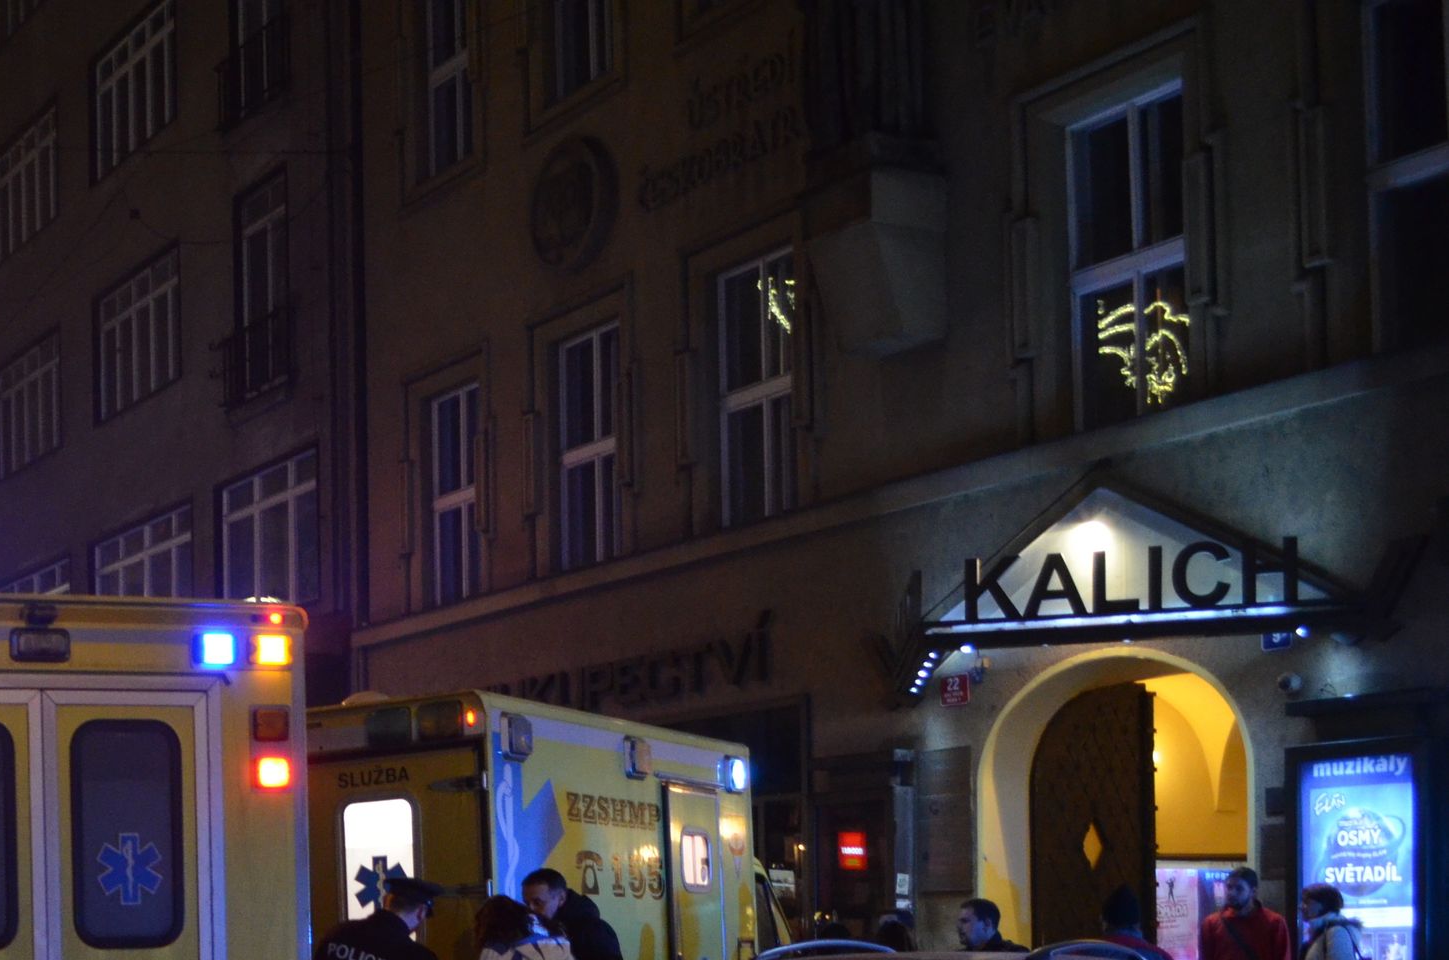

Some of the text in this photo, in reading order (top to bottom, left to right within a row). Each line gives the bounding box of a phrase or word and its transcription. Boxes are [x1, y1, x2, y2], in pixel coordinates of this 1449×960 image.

[964, 536, 1299, 622] KALICH
[337, 764, 410, 789] SLUŽBA
[1313, 754, 1409, 778] muzikály
[1336, 823, 1382, 847] OSMÝ
[611, 851, 666, 901] 155
[1324, 861, 1403, 884] SVĚTADÍL
